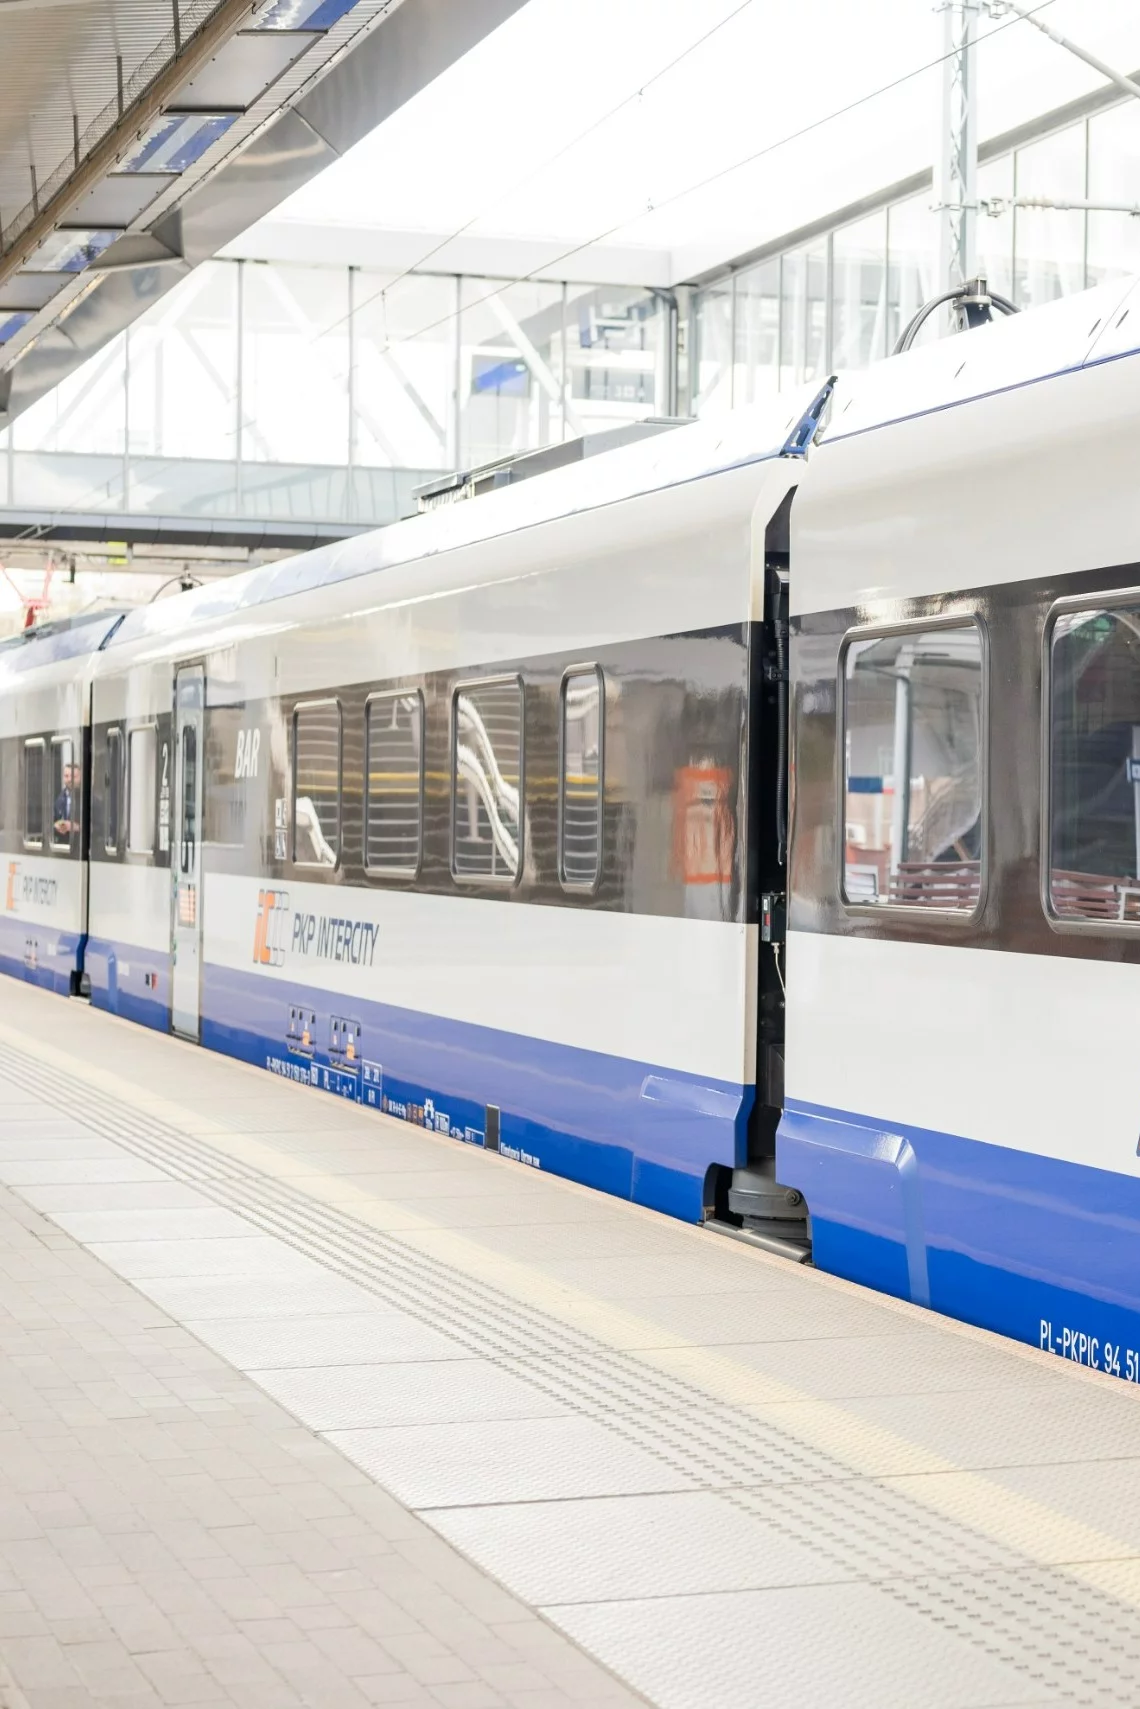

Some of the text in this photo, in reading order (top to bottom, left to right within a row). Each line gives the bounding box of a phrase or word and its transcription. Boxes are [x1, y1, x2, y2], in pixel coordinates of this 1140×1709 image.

[162, 743, 168, 786] 2
[235, 728, 260, 778] BAR
[292, 912, 380, 966] PKP INTERCITY
[1040, 1320, 1099, 1369] PL-PKPIC
[1104, 1343, 1120, 1377] 94
[1125, 1349, 1139, 1384] 51
